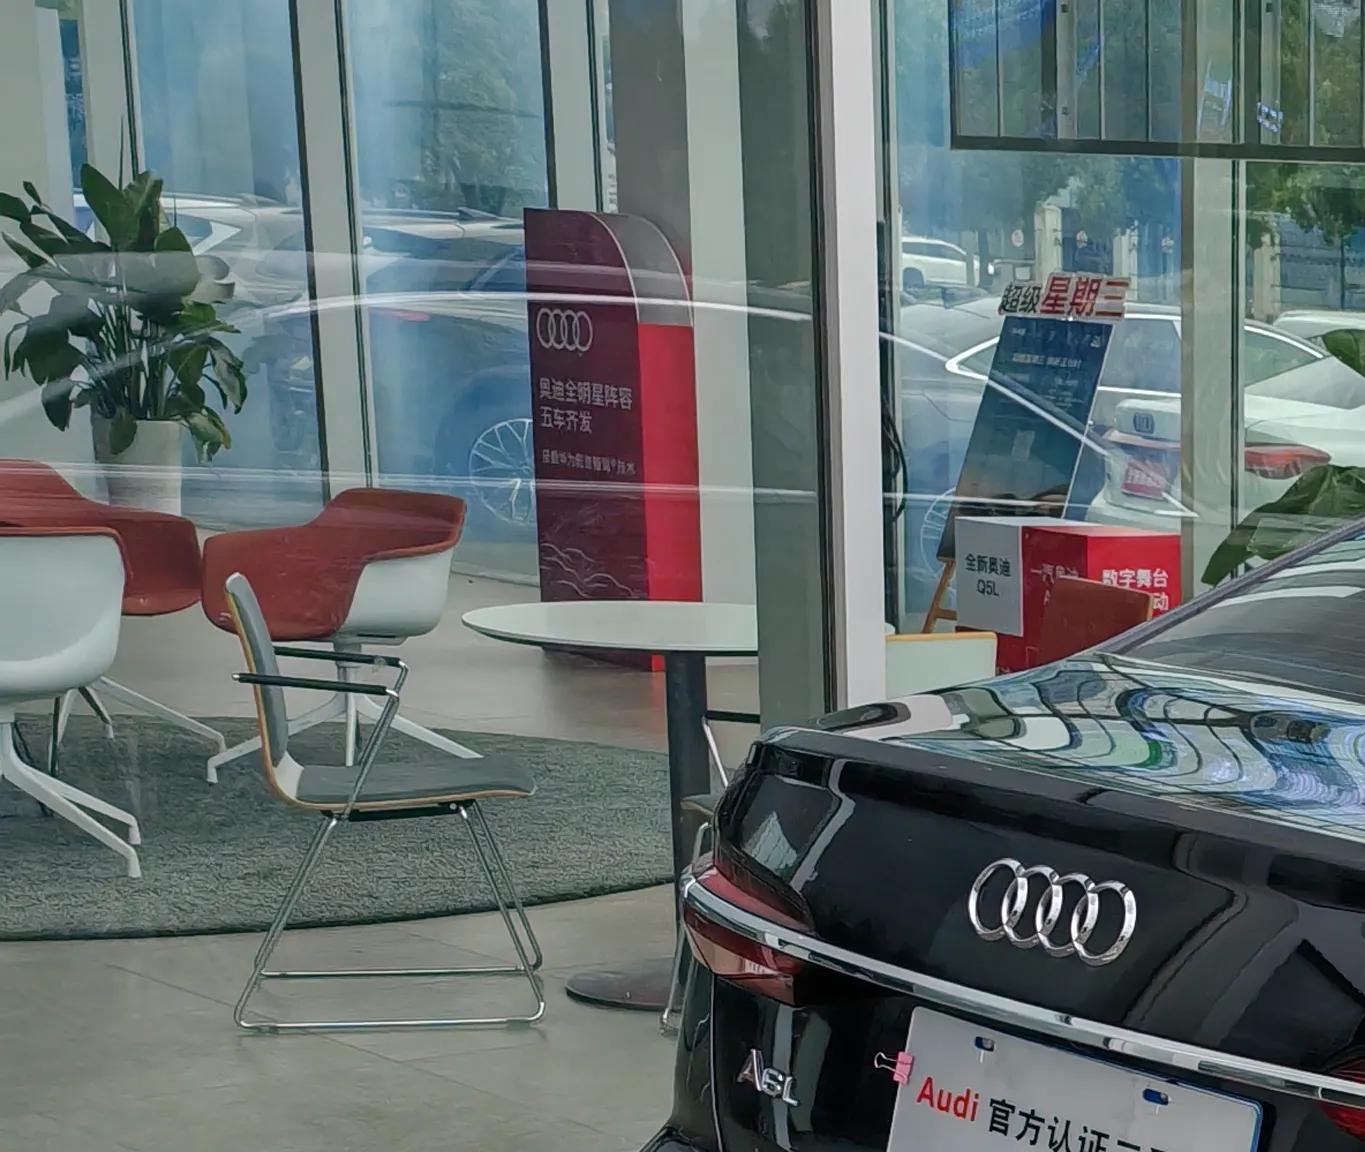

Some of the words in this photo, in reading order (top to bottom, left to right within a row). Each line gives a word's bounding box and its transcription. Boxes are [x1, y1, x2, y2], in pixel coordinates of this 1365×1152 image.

[1000, 276, 1129, 316] 超级星期三
[540, 377, 632, 410] 奥迪全明星阵容
[541, 405, 592, 433] 五车齐发
[965, 553, 1011, 577] 全新奥迪
[1102, 568, 1168, 588] 数字舞台
[977, 579, 1000, 597] Q5L
[737, 1048, 798, 1106] A6L
[916, 1077, 979, 1122] Audi
